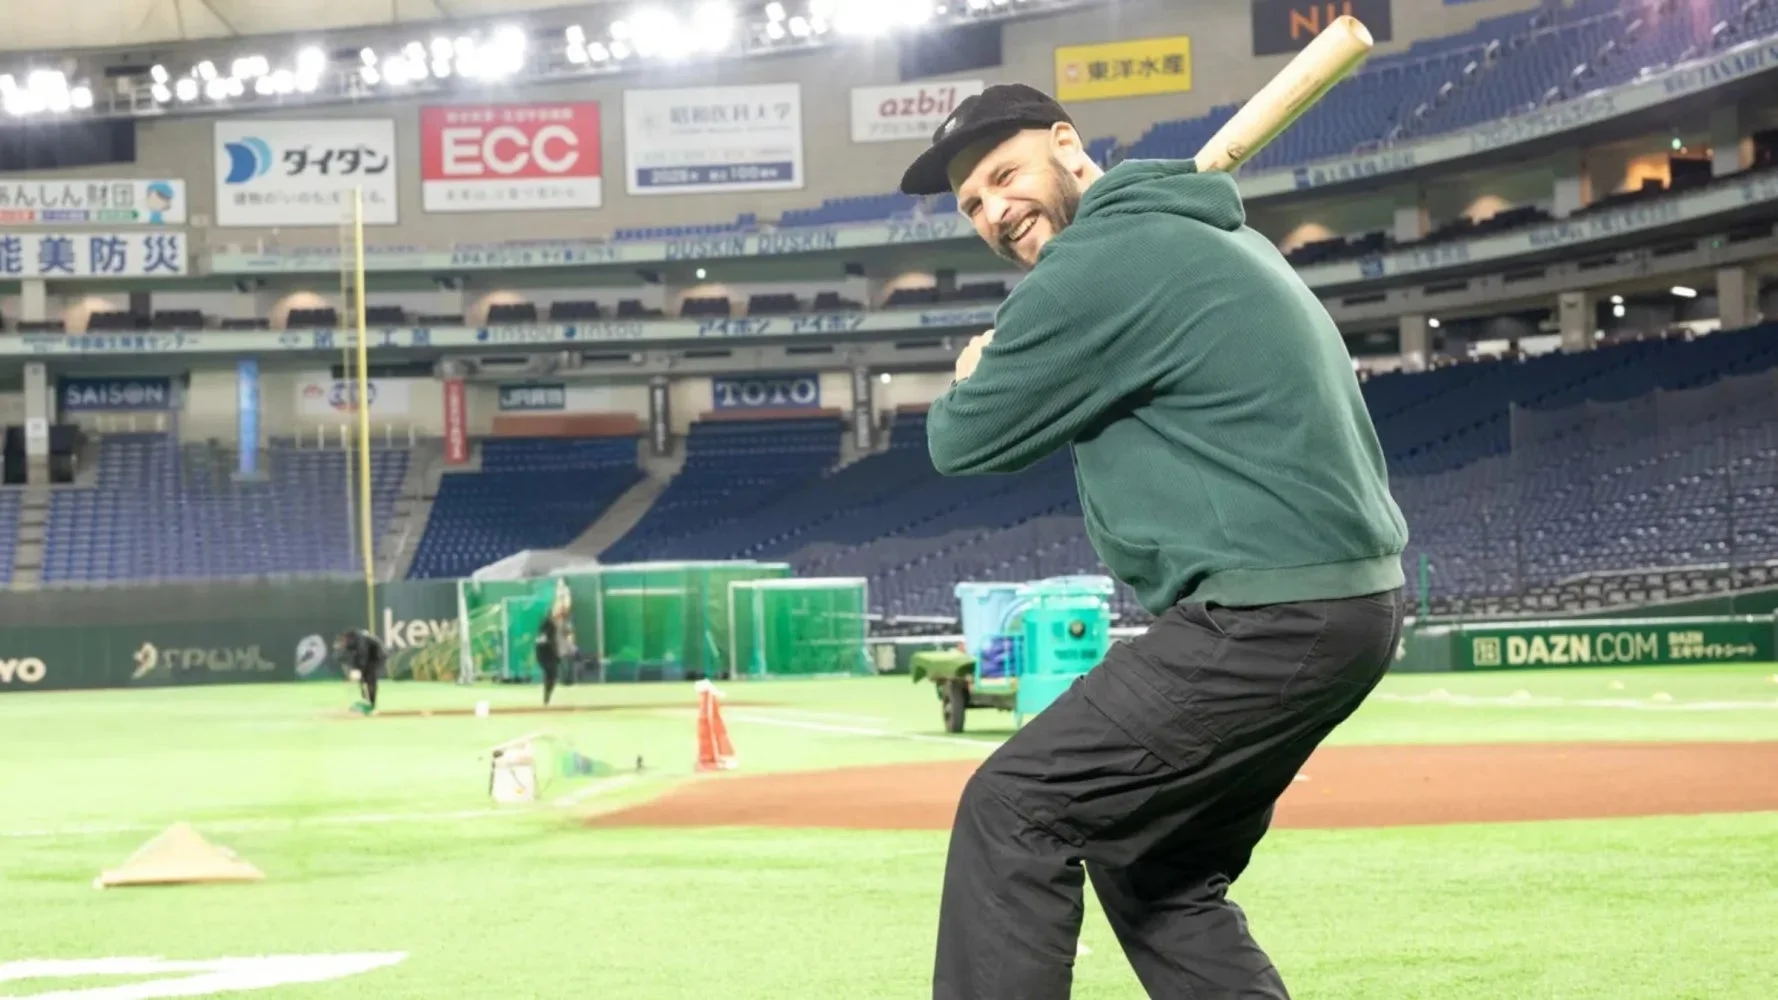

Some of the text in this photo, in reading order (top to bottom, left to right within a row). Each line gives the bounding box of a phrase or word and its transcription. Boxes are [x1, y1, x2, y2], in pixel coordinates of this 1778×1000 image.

[1088, 53, 1184, 81] 東洋水産
[880, 86, 956, 118] azbil
[442, 124, 579, 175] ECC
[665, 228, 837, 260] DUSKIN DUSKIN
[66, 382, 163, 405] SAISON
[716, 379, 816, 406] TOTO
[1506, 632, 1659, 665] DAZN.COM
